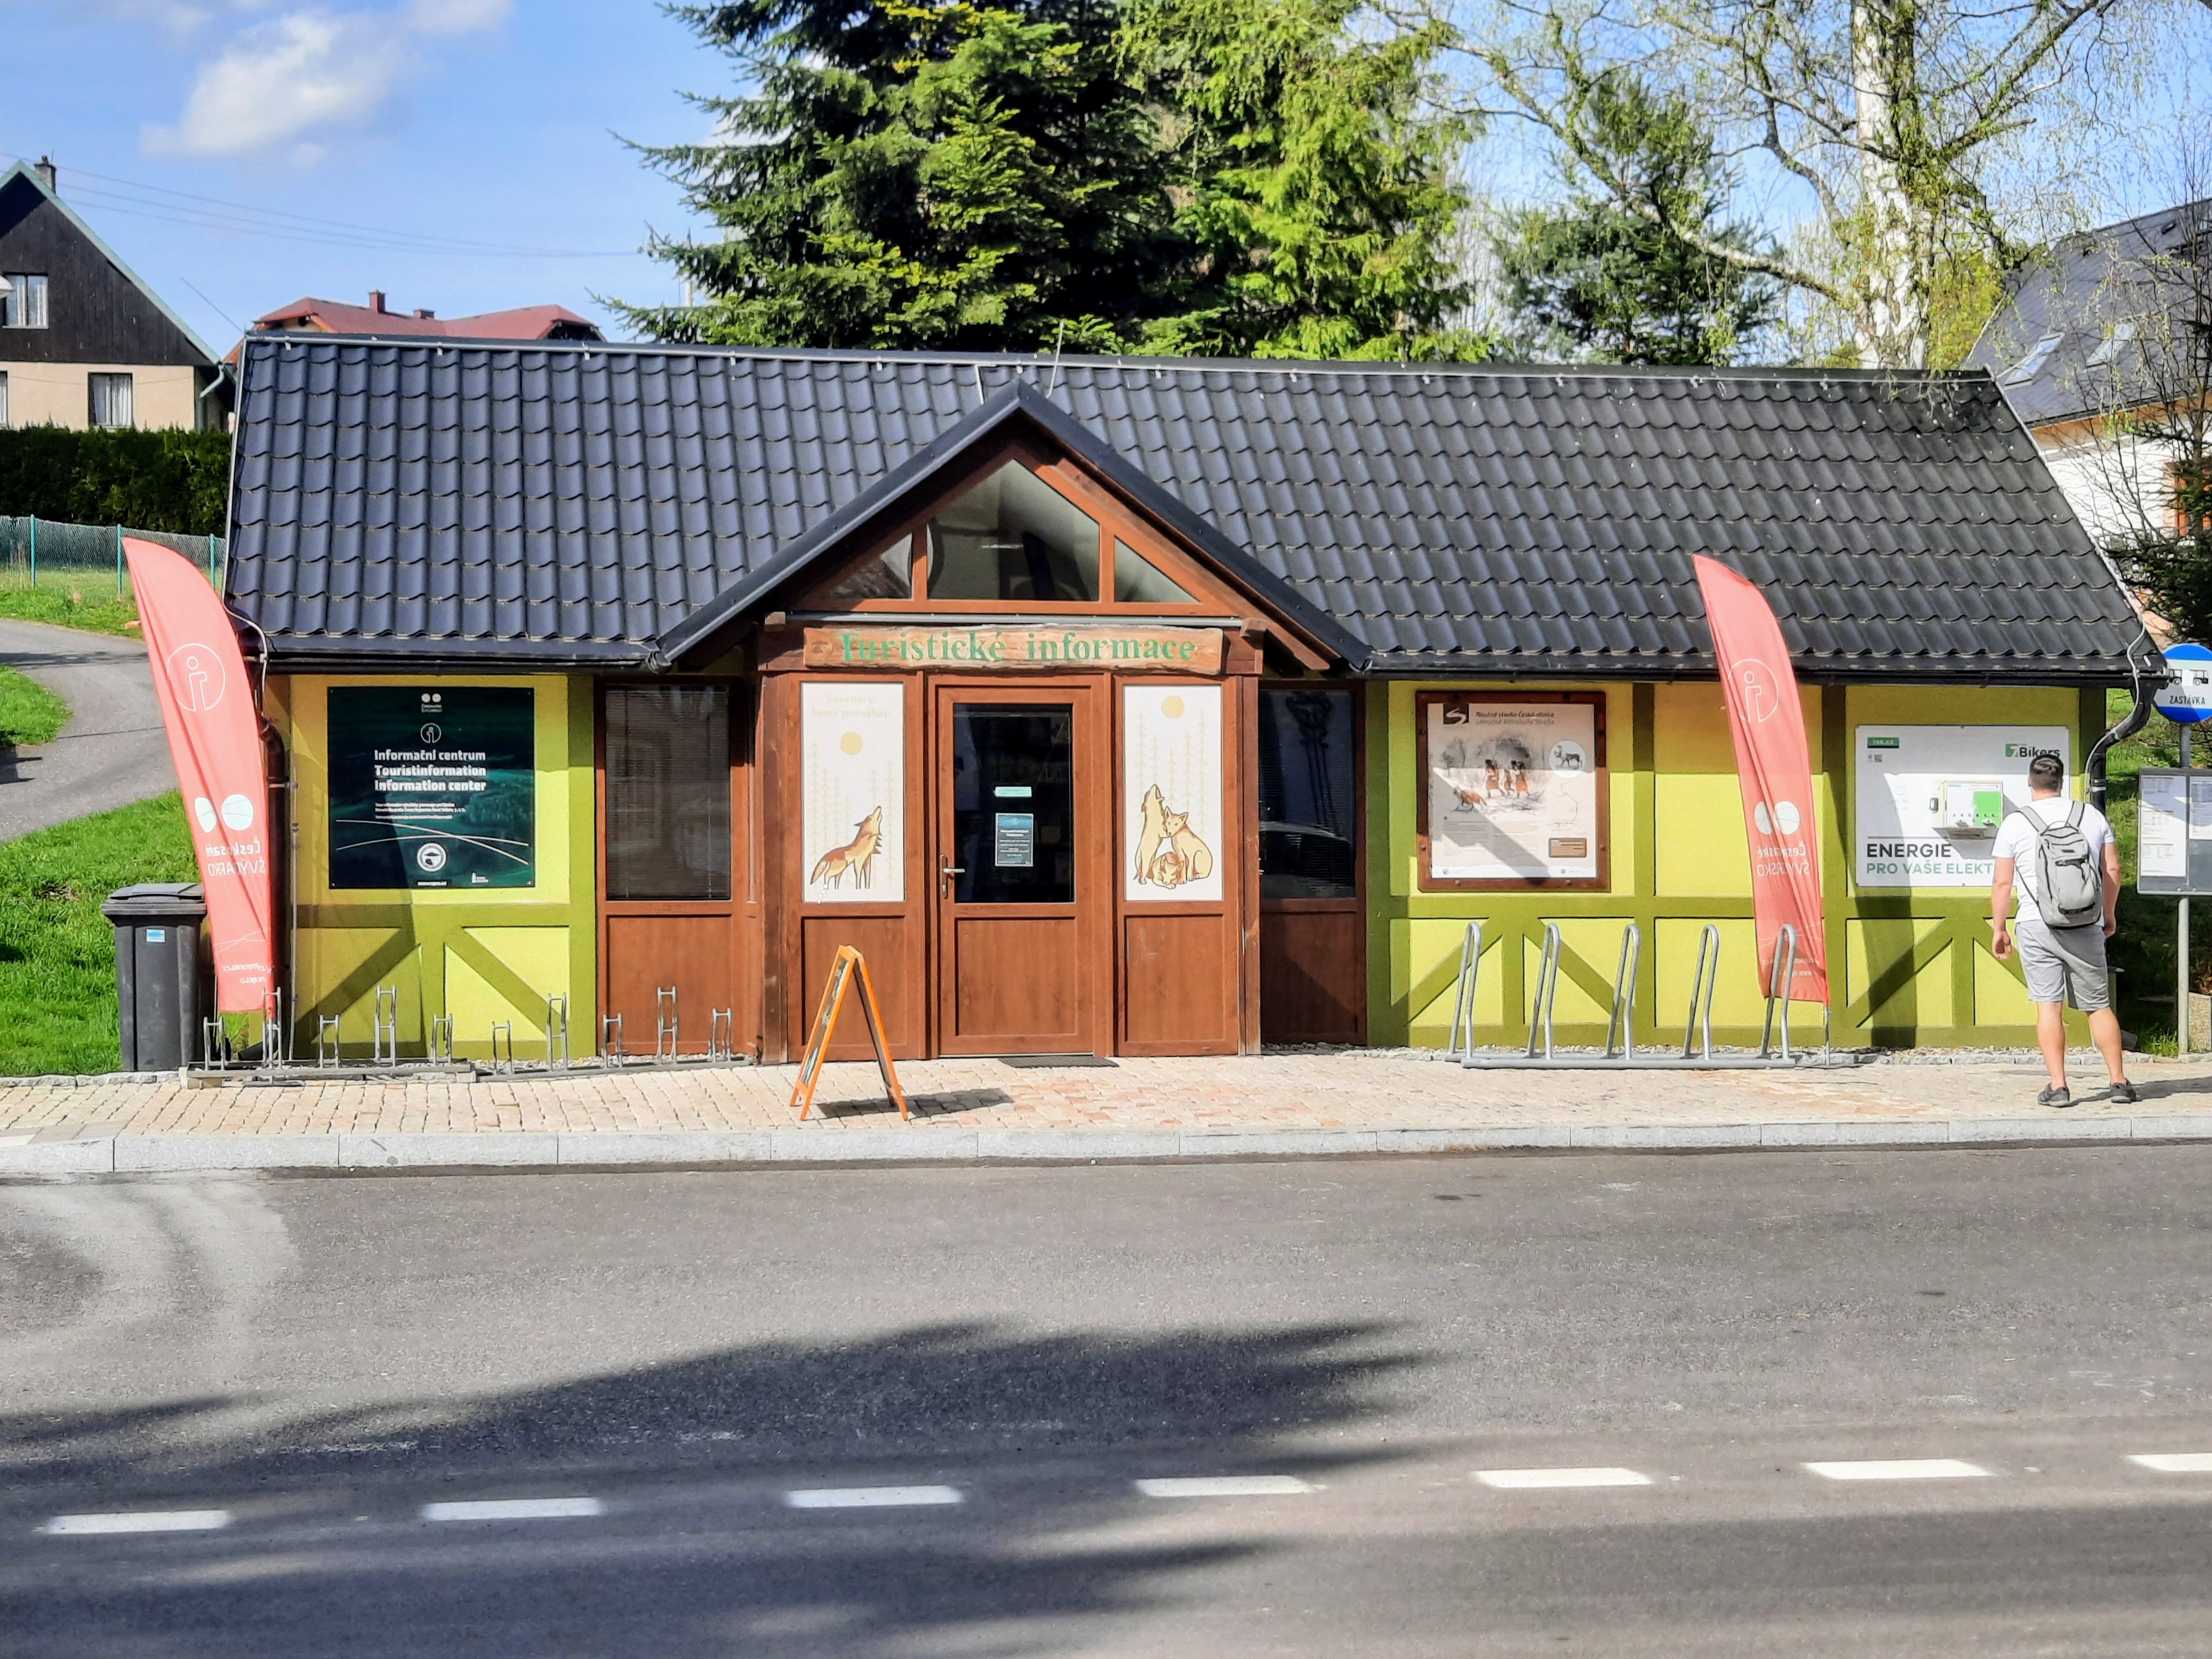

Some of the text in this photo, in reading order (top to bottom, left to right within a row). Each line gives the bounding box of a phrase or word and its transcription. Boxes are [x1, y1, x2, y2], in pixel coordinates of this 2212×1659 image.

[836, 630, 1195, 662] Turistické informace
[2169, 694, 2205, 706] ZASTÁVKA
[374, 749, 486, 761] Informační centrum
[374, 764, 487, 776] Touristinformation
[374, 779, 487, 791] Information center
[1867, 843, 1952, 858] ENERGIE
[1867, 859, 1994, 874] PRO VAŠE ELEKT
